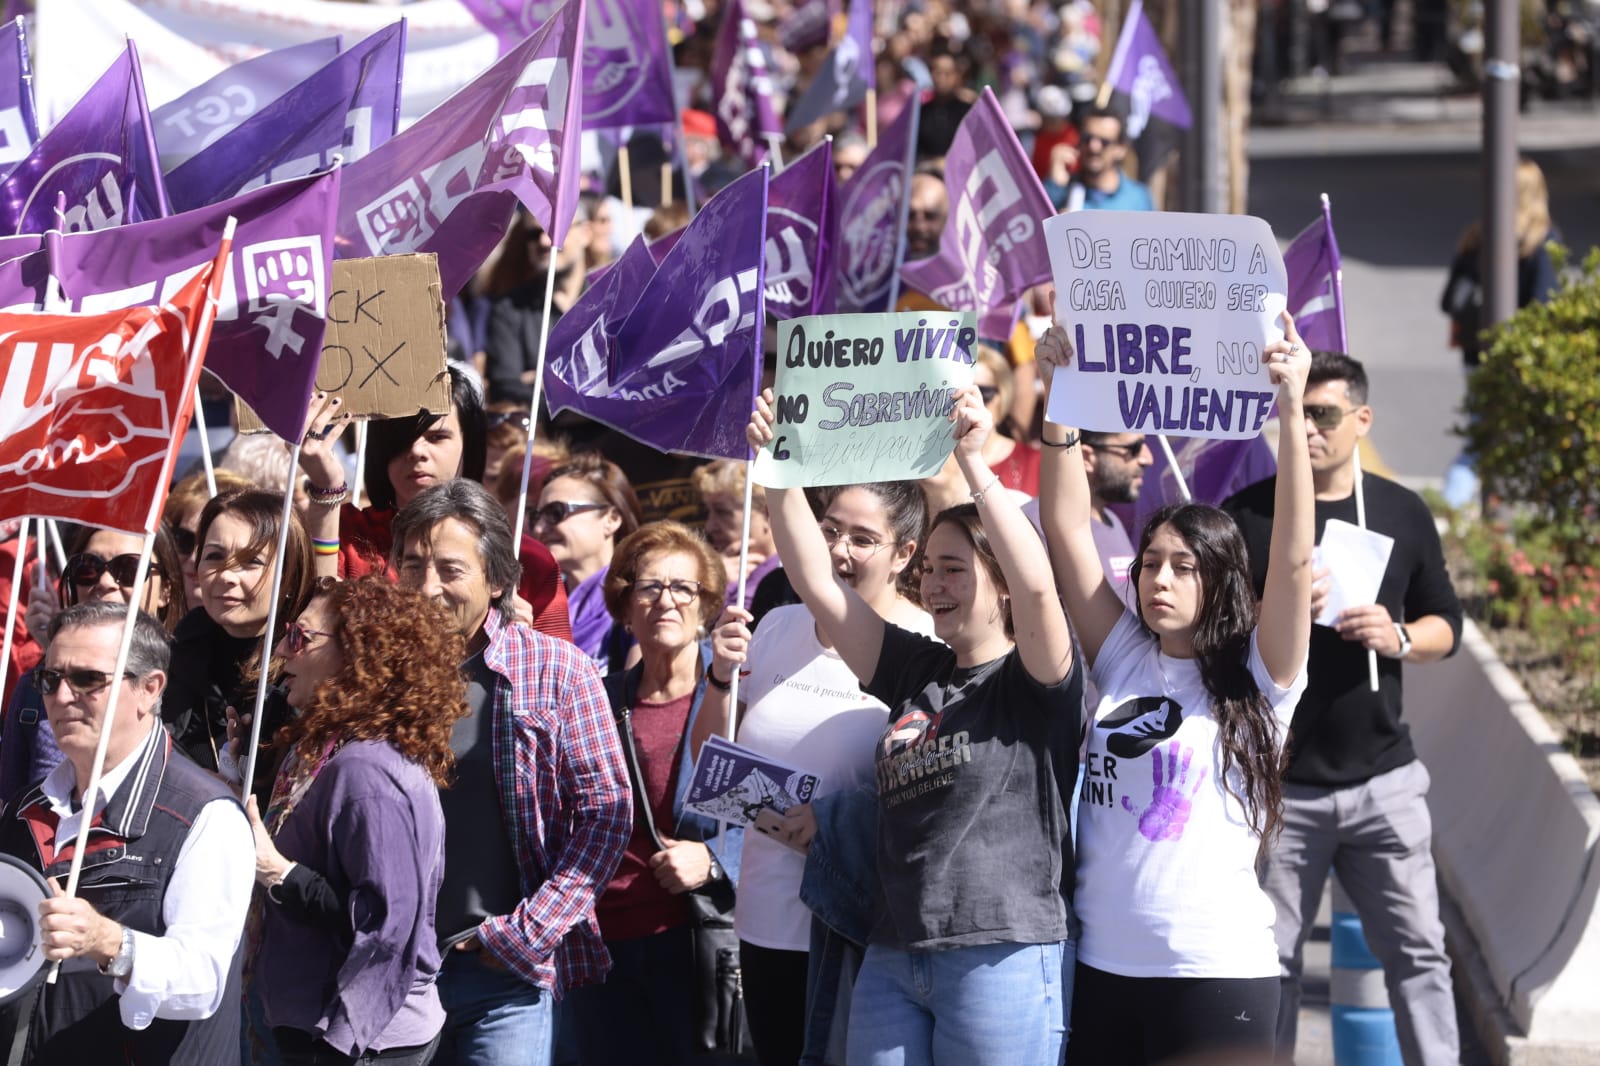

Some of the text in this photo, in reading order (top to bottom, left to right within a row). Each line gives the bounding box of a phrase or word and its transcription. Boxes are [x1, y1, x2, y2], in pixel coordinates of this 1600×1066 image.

[1066, 228, 1268, 275] DE CAMINO A
[327, 289, 386, 326] CK
[1069, 278, 1269, 313] CASA QUIERO SER
[785, 323, 885, 369] QUIERO
[1075, 323, 1260, 383] LIBRE, NO
[776, 393, 810, 425] NO
[1117, 380, 1275, 433] VALIENTE
[786, 680, 812, 692] coeur
[820, 686, 859, 701] prendre
[799, 773, 818, 800] CGT
[902, 787, 918, 801] YOU
[918, 771, 955, 795] BELIEVE
